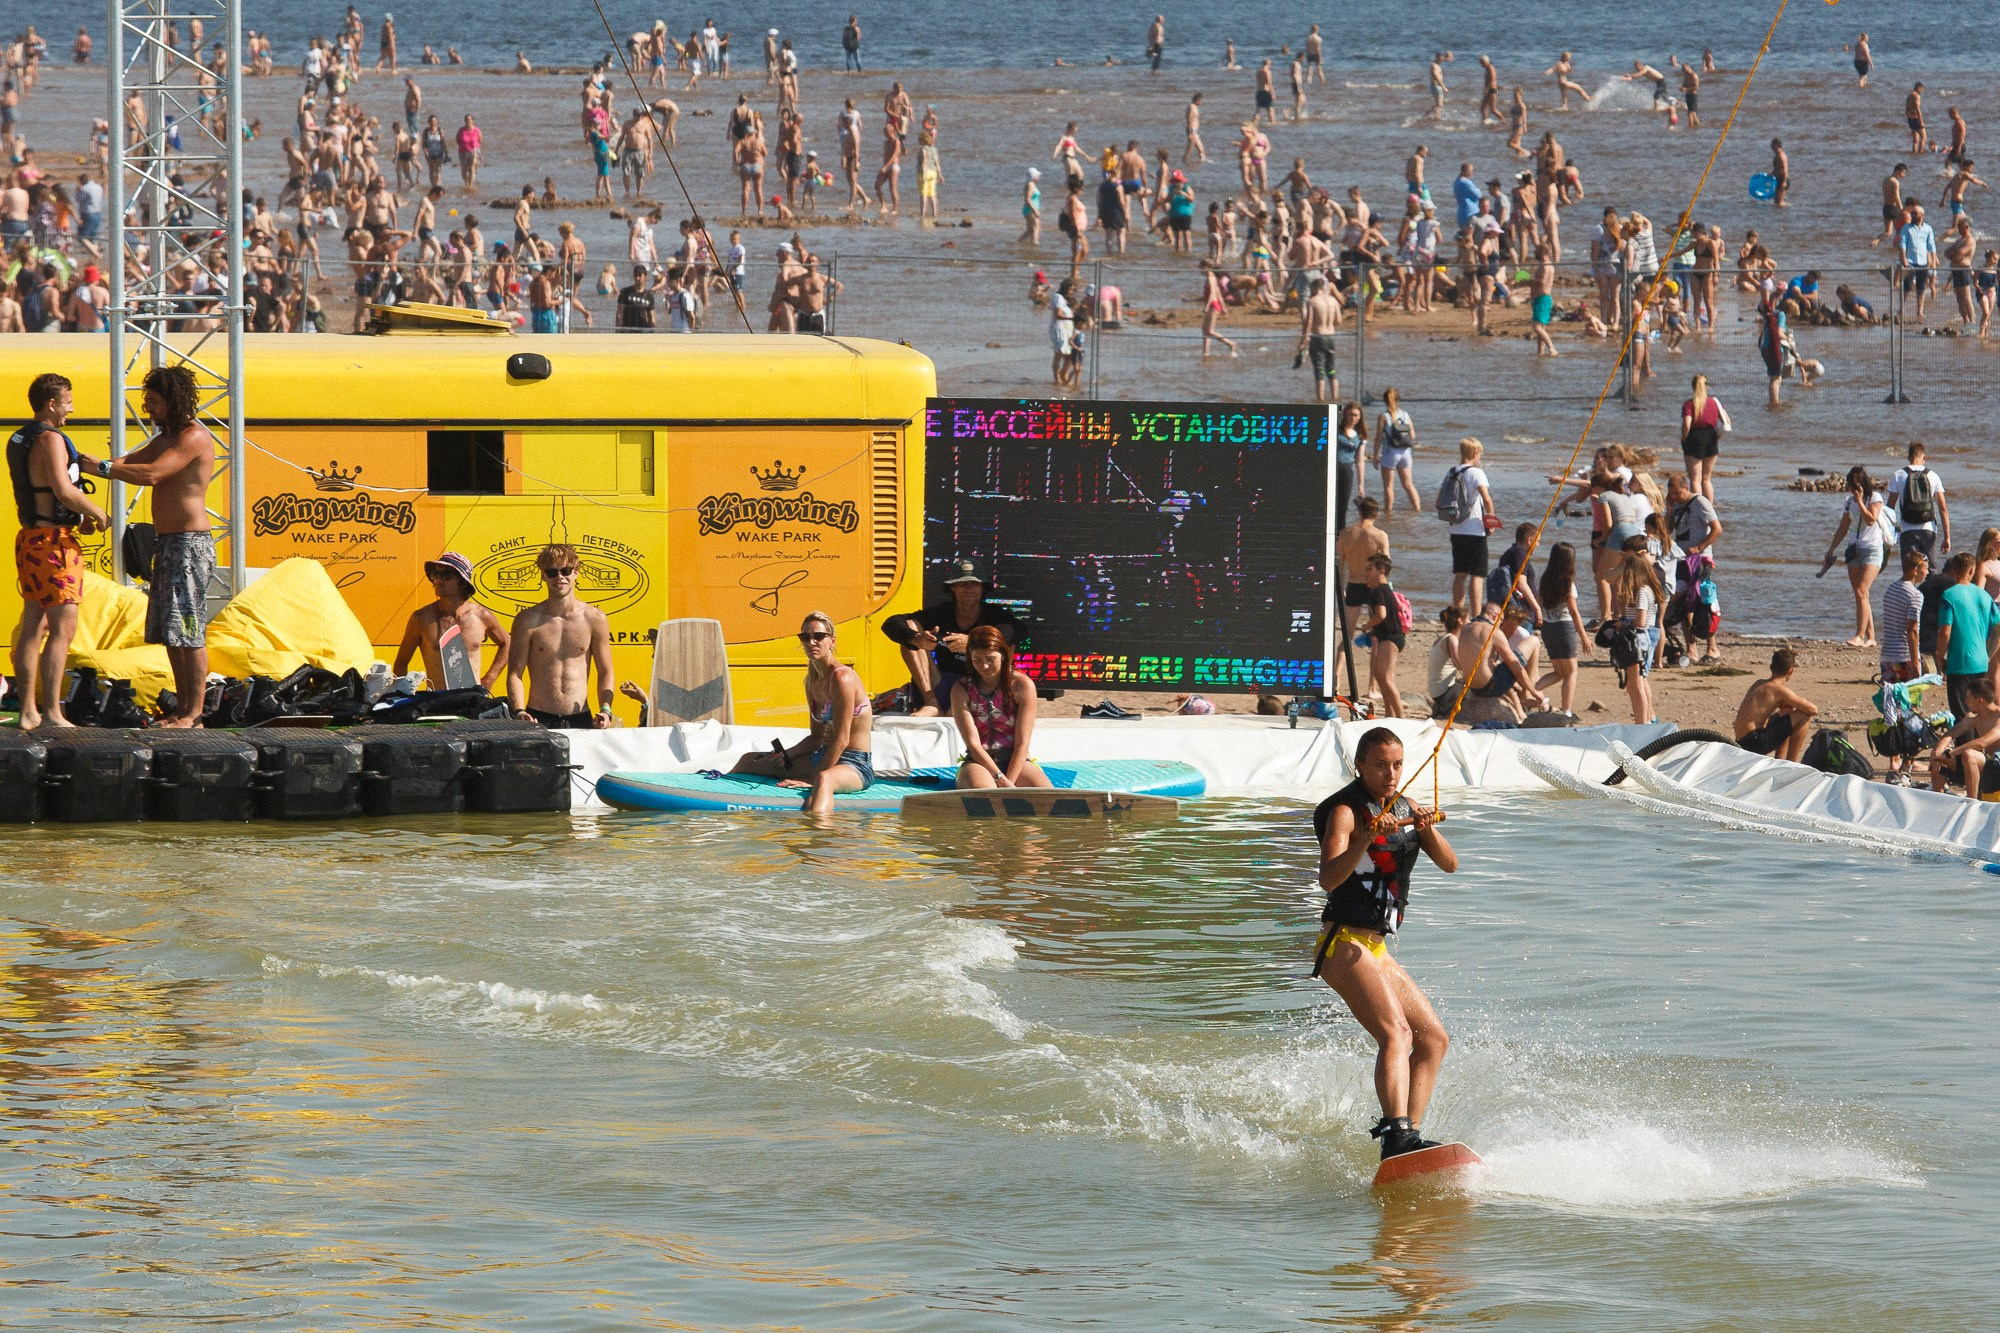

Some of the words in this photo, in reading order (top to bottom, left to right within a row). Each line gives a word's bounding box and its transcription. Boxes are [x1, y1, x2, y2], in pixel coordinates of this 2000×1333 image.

[953, 403, 1120, 447] БАССЕЙНЫ,
[1130, 412, 1309, 443] УСТАНОВКИ
[252, 492, 417, 537] Kingwinch
[698, 491, 860, 536] Kingwinch
[291, 532, 335, 543] WAKE
[339, 532, 379, 543] PARK
[489, 536, 527, 553] САНКТ
[582, 534, 646, 562] ПЕТЕРБУРГ
[736, 531, 780, 543] WAKE
[783, 531, 822, 543] PARK
